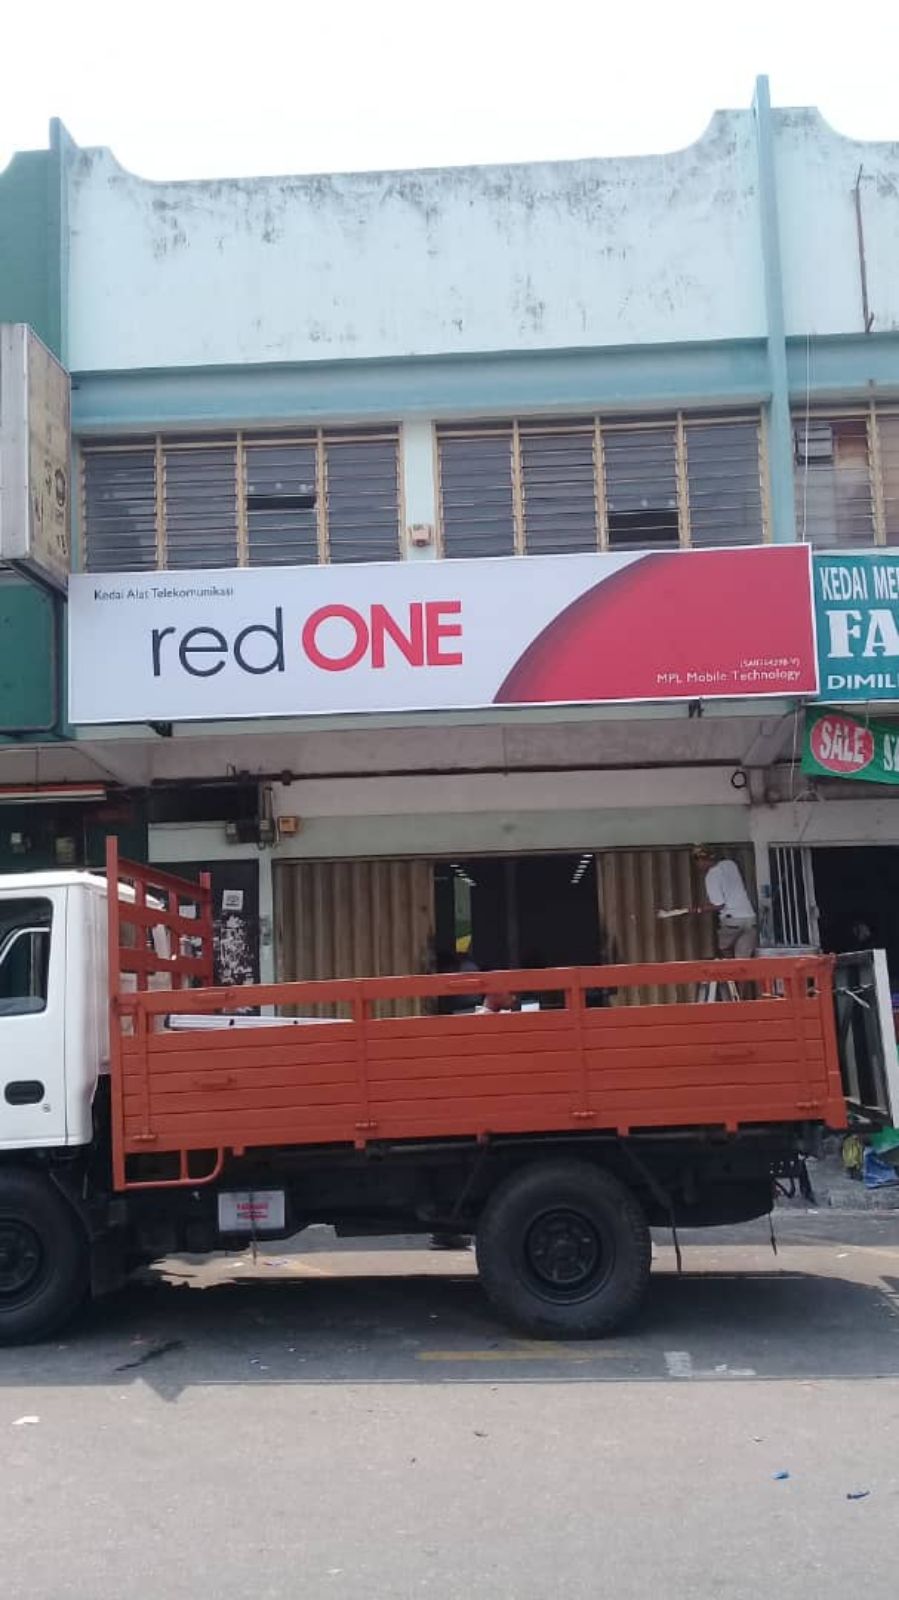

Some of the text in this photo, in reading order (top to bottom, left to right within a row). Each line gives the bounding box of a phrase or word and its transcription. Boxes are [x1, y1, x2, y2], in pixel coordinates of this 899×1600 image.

[820, 565, 899, 600] KEDAI ME
[94, 586, 234, 600] Kedai Alat Telekomunikasi
[657, 669, 801, 684] MPL Mobile Technology
[827, 673, 899, 690] DIMIL
[820, 721, 865, 764] SALE
